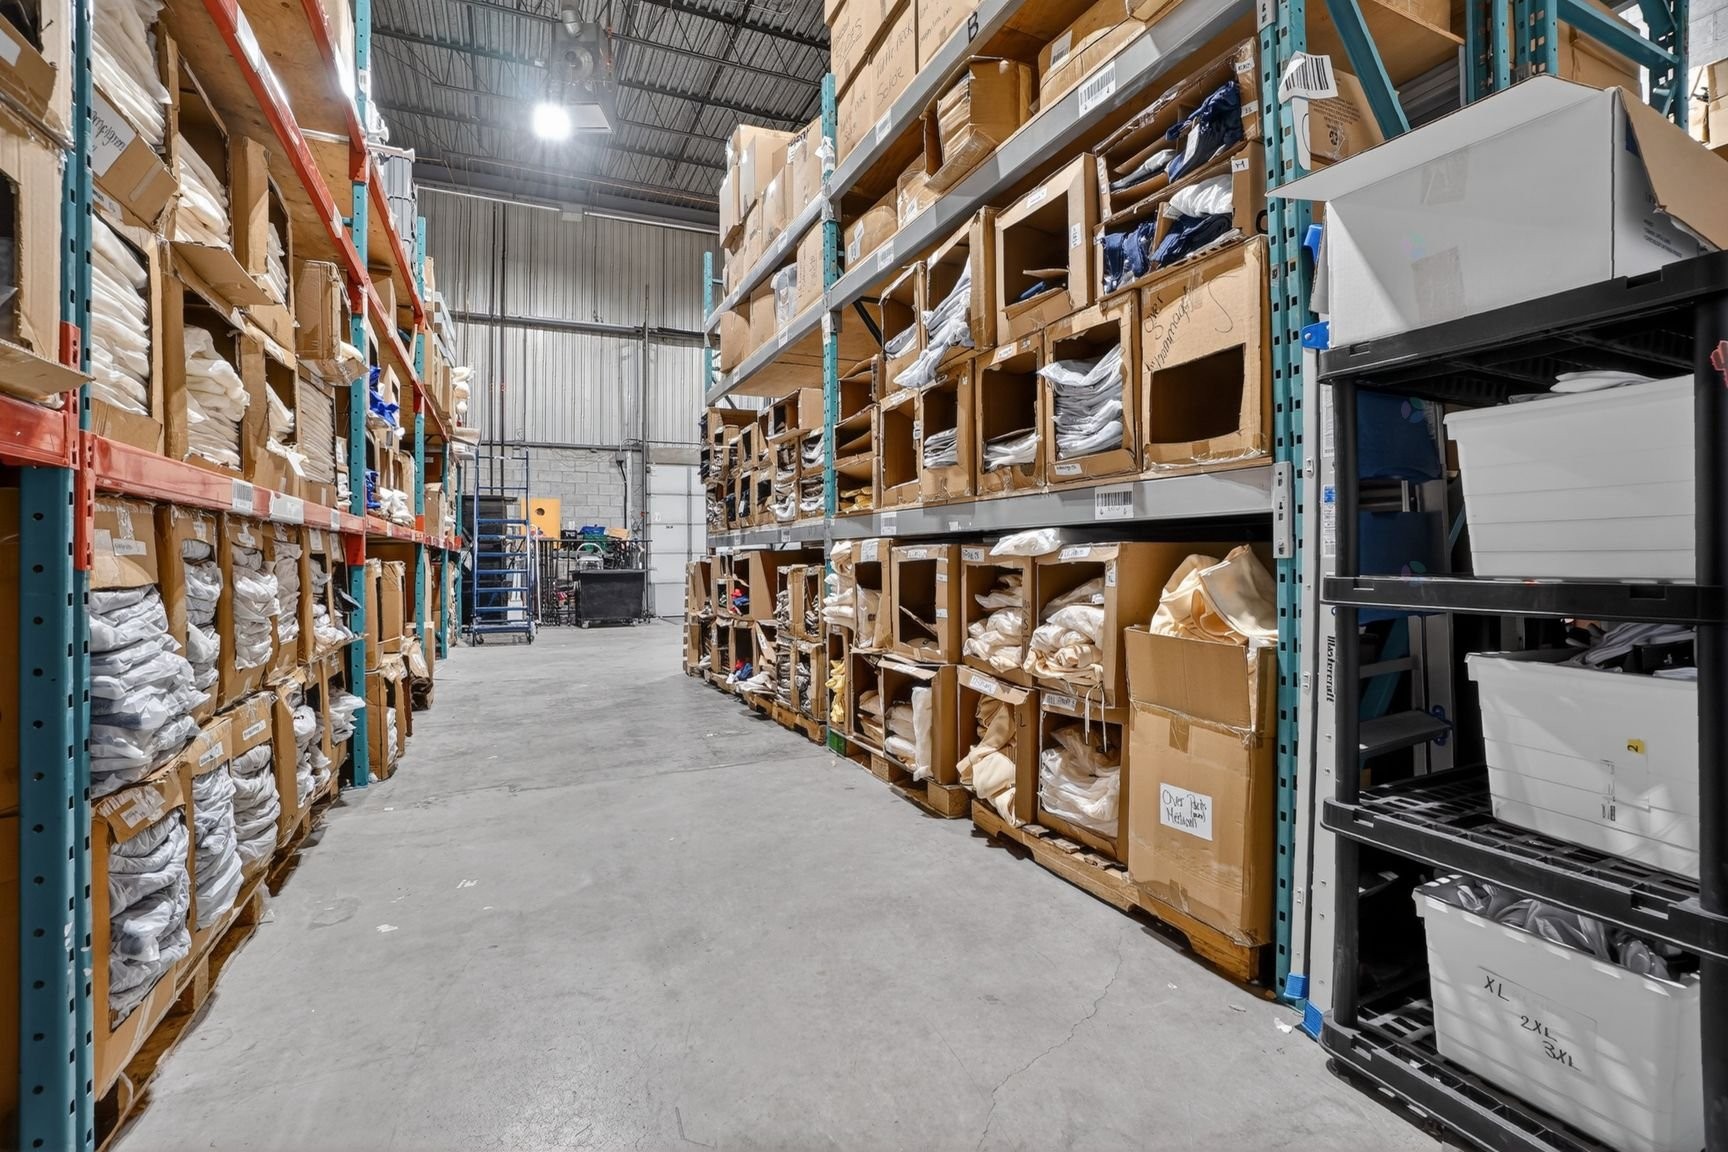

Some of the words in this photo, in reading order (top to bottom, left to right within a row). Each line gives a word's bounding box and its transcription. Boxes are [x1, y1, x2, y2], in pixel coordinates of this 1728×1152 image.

[967, 11, 979, 44] B
[1627, 744, 1639, 753] 2
[1484, 975, 1510, 1002] XL
[1520, 1015, 1558, 1042] 2XL
[1541, 1040, 1582, 1072] 3XL
